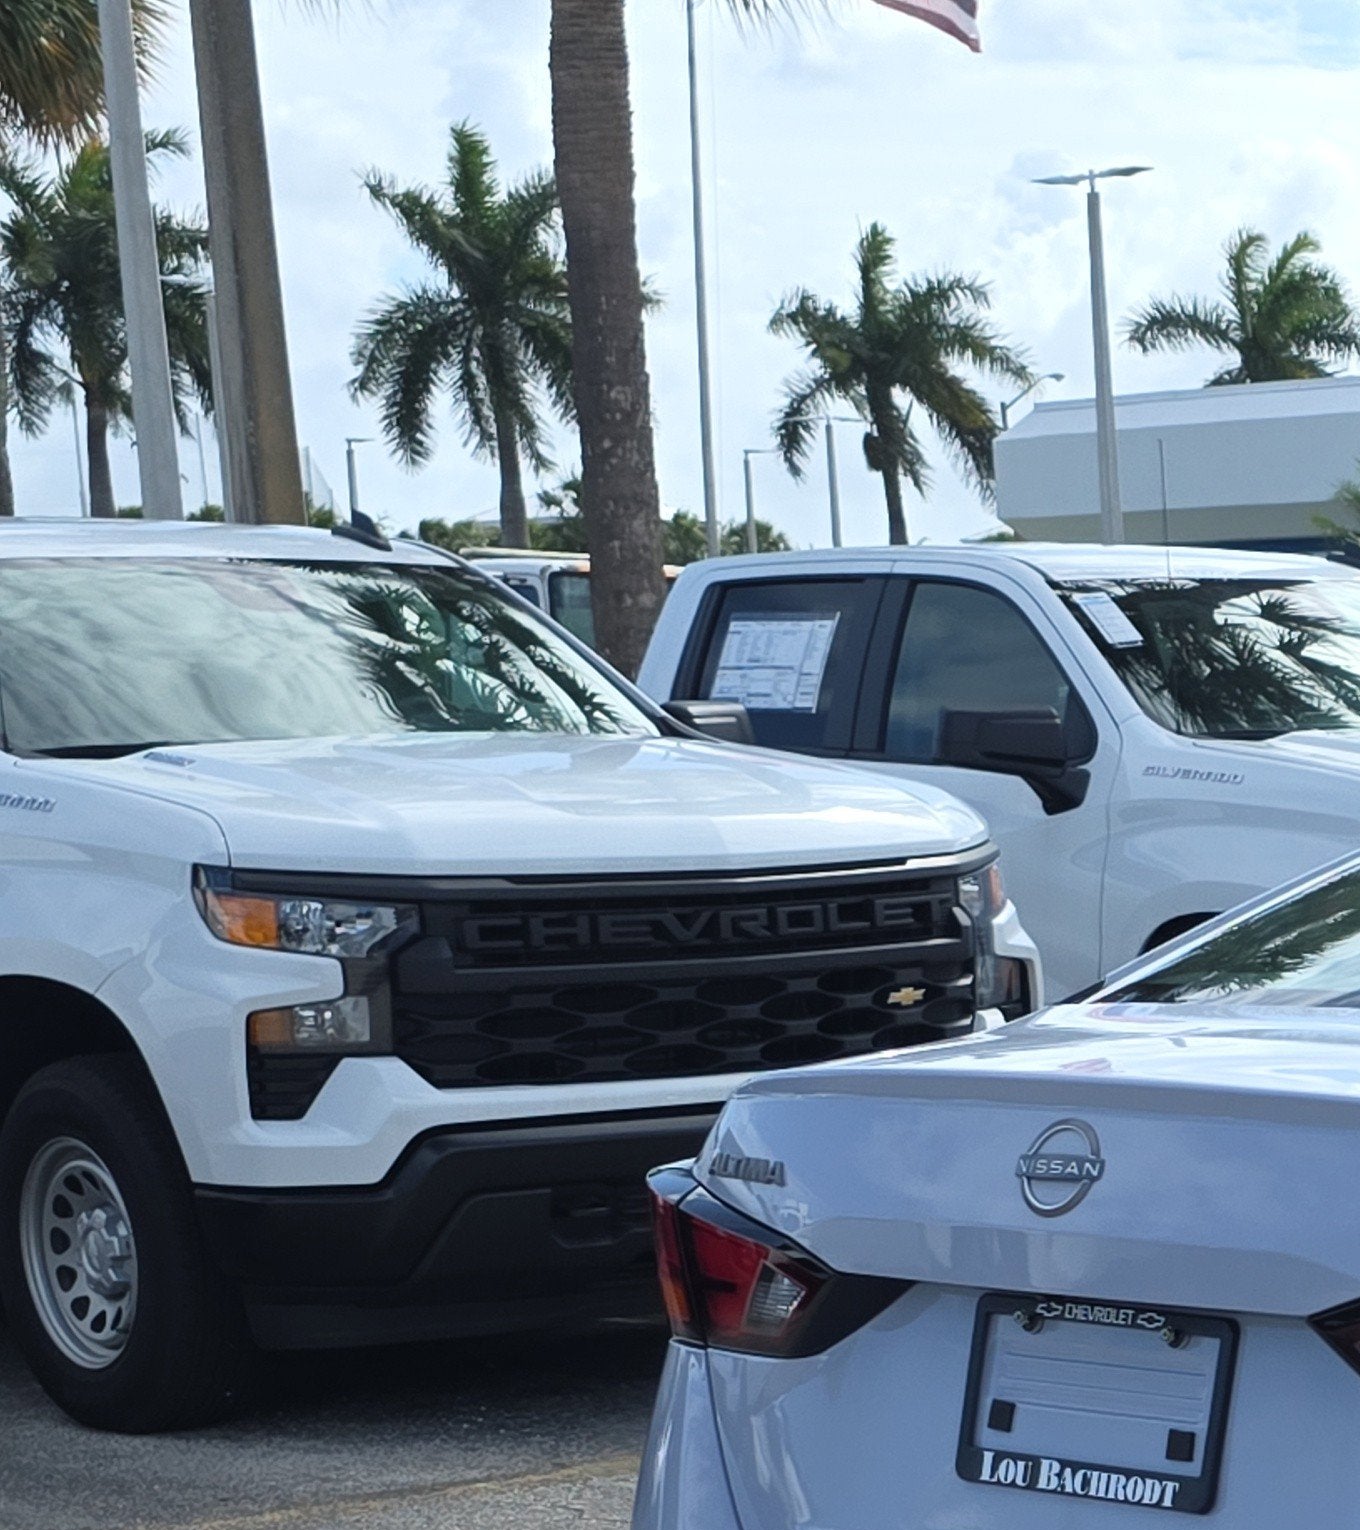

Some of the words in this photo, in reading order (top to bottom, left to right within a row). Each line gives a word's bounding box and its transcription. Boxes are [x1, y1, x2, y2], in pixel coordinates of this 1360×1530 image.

[461, 894, 955, 951] CHEVROLET
[1020, 1158, 1100, 1177] NISSAN
[1064, 1302, 1136, 1326] CHEVROLET
[980, 1450, 1033, 1487] LOU
[1036, 1457, 1180, 1508] BACHRODT
